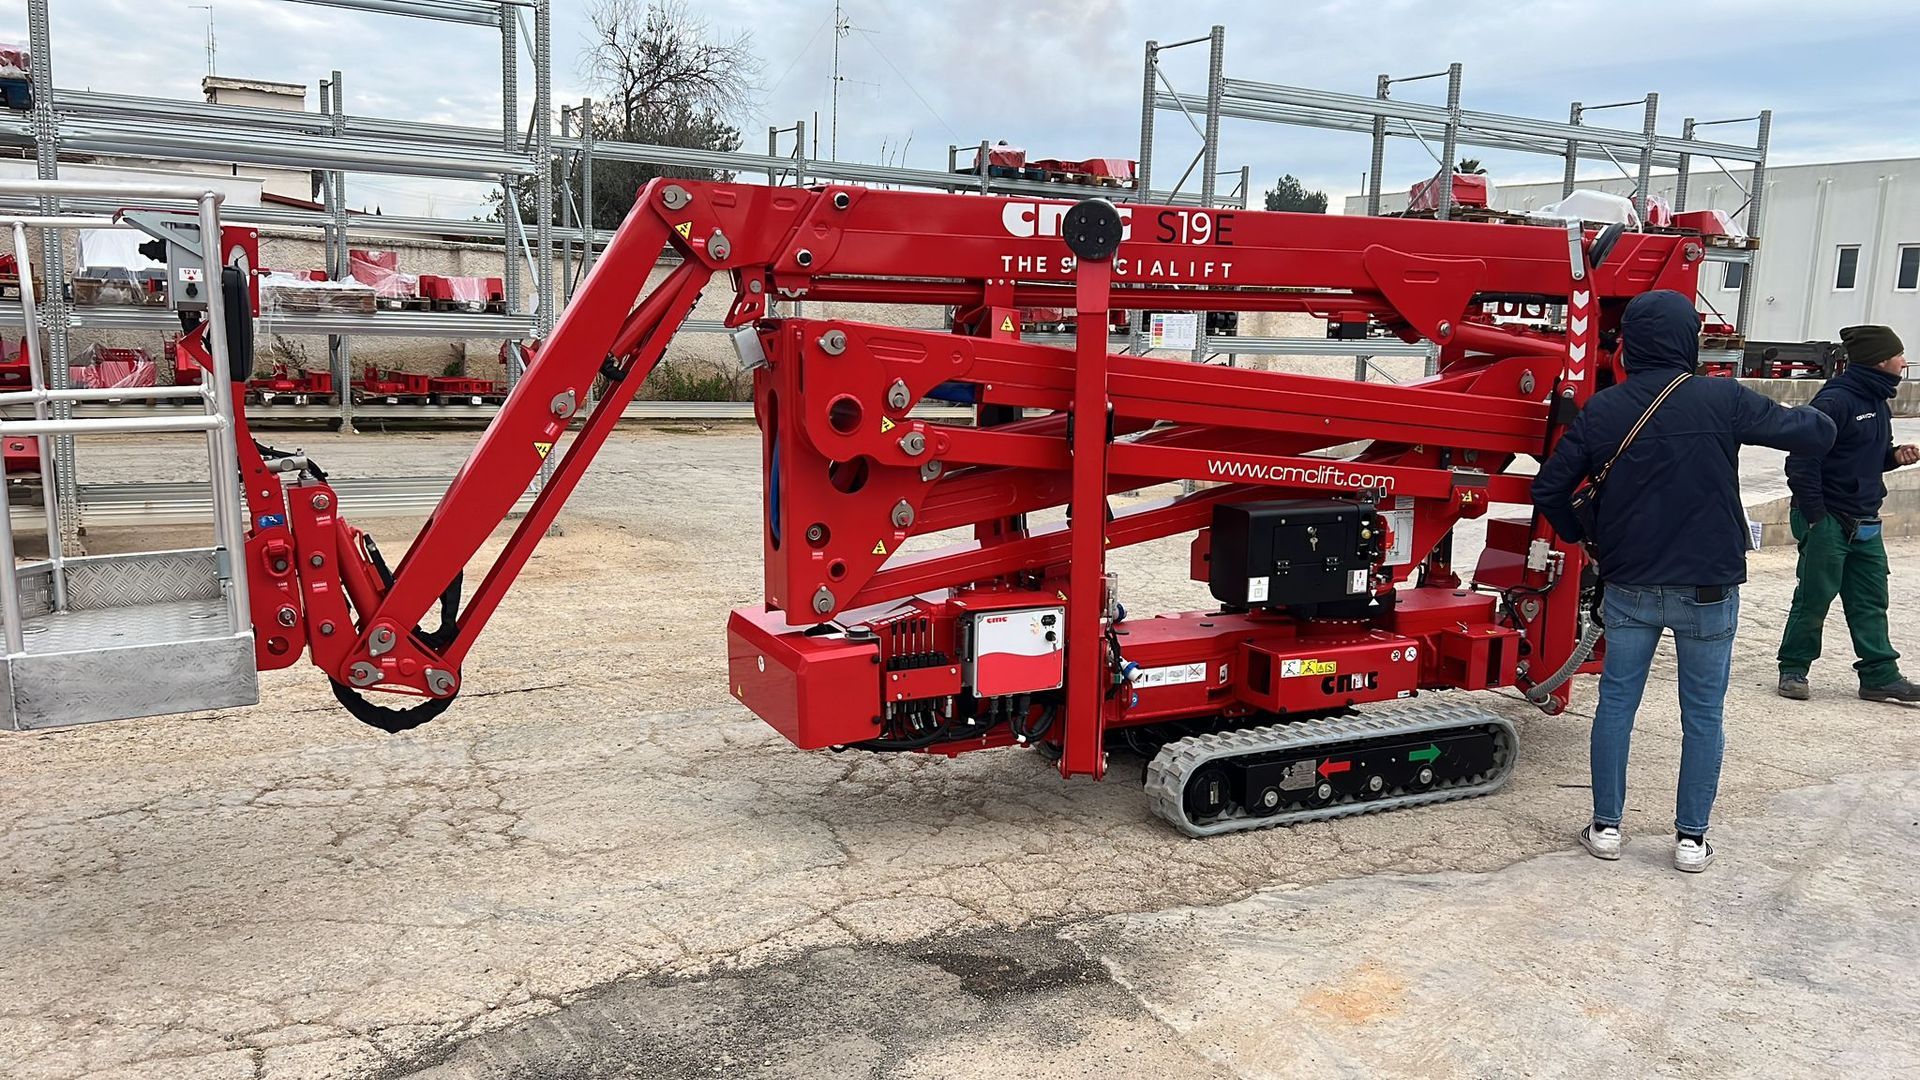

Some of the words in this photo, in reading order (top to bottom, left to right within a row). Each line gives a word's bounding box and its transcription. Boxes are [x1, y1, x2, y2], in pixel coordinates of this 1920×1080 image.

[1156, 210, 1235, 246] S19E
[1001, 255, 1047, 273] THE
[1060, 259, 1233, 278] SCIALIFT
[1207, 459, 1395, 490] www.cmclift.com
